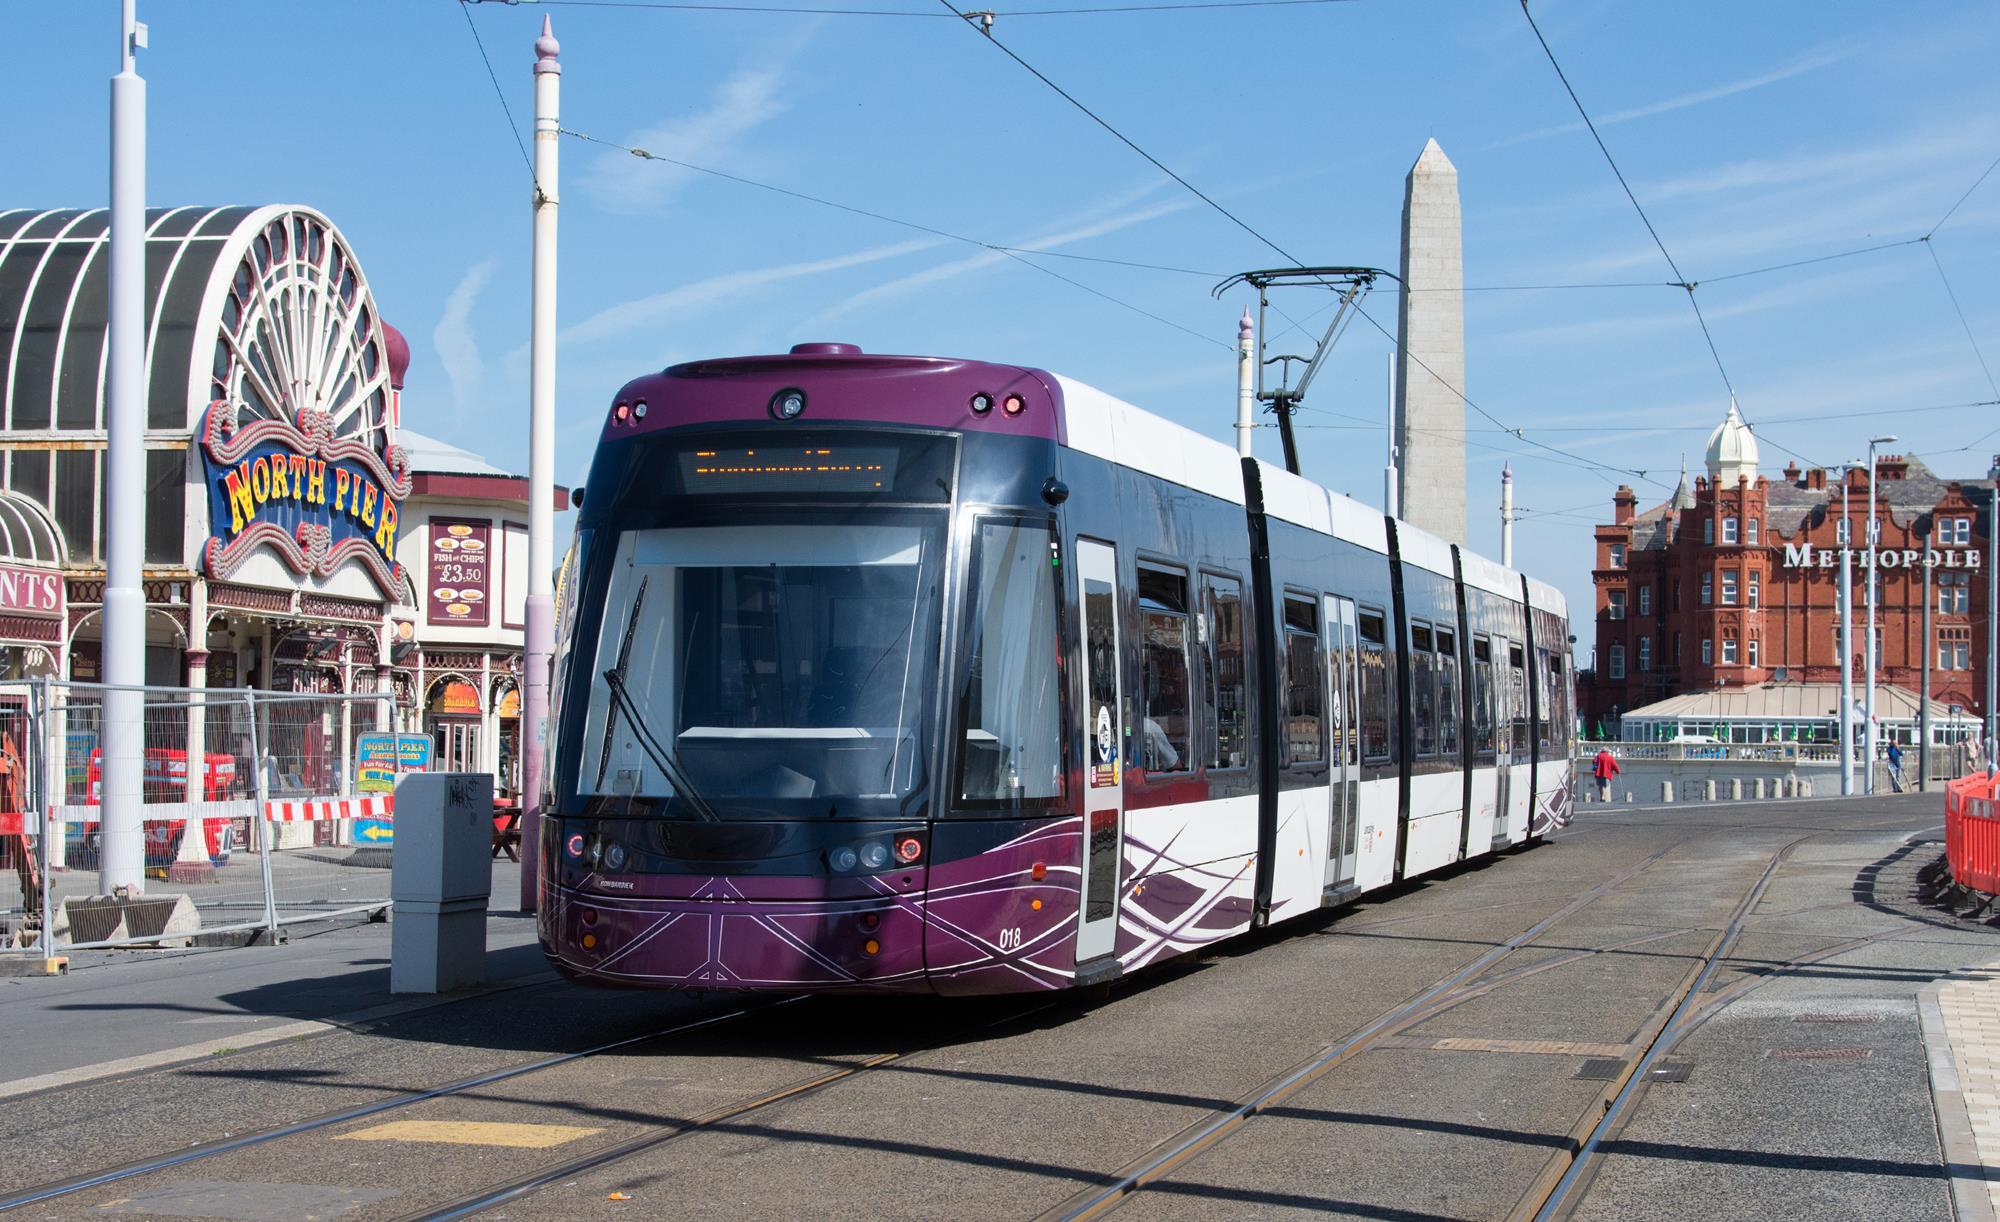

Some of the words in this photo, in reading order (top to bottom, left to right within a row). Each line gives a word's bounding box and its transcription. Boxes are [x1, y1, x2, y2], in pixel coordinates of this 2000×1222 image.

[225, 453, 326, 535] NORTH
[335, 467, 398, 562] PIER
[434, 553, 452, 562] FISH
[460, 554, 484, 564] CHIPS
[440, 564, 482, 583] £3.50
[1000, 927, 1021, 948] 018
